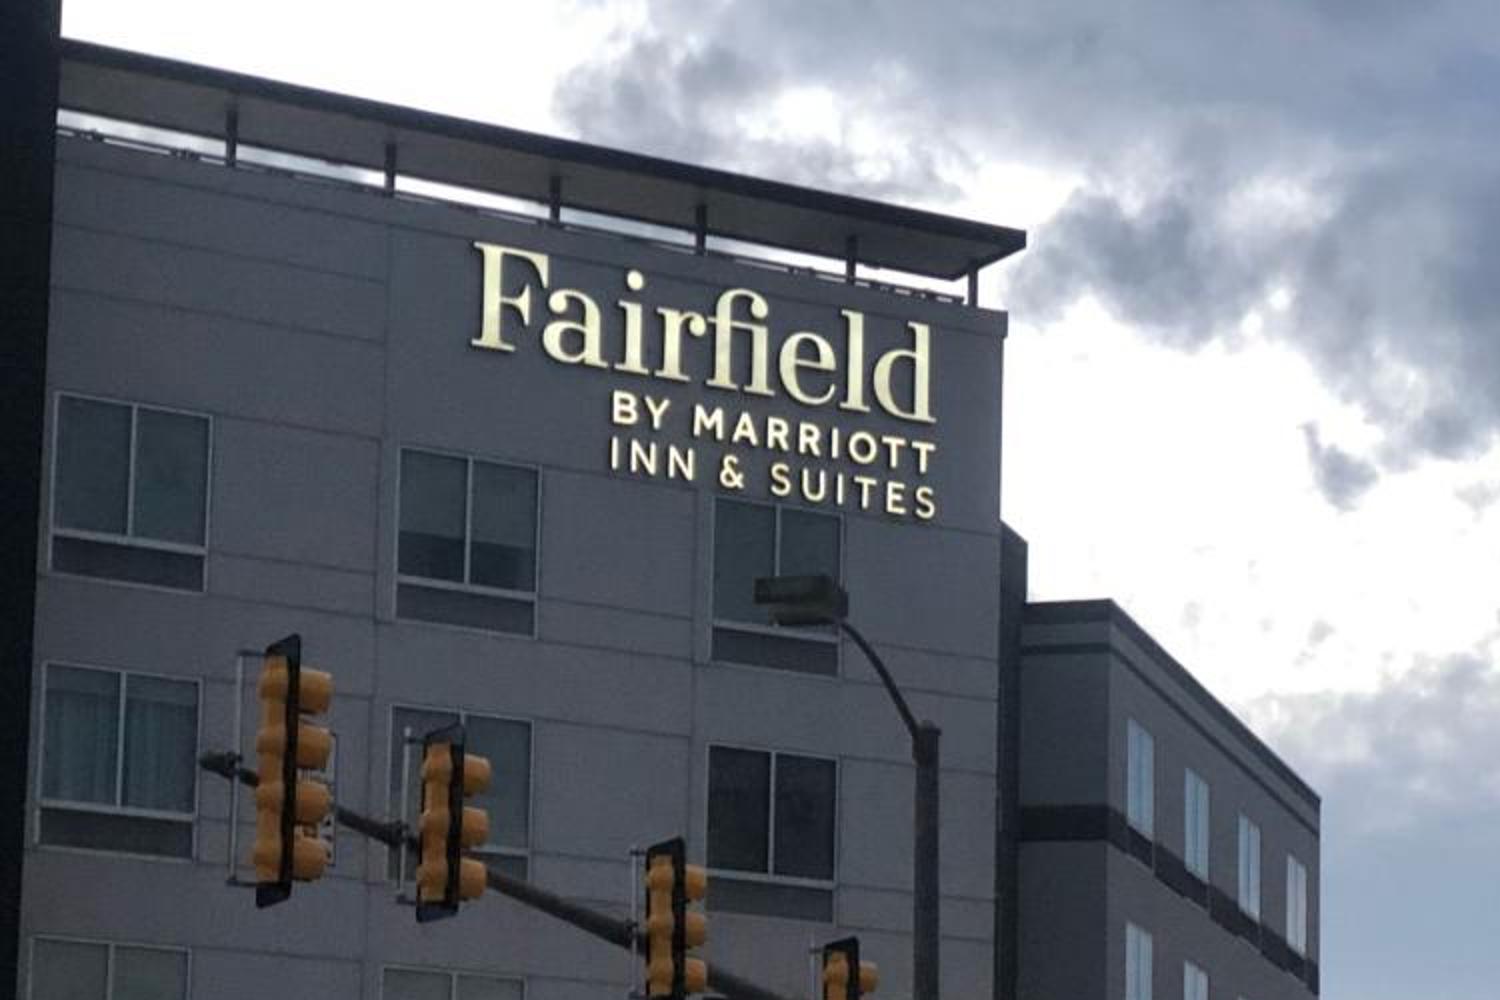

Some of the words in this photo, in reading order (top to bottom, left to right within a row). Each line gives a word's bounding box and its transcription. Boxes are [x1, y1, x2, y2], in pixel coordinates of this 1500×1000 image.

[471, 241, 937, 423] Fairfield
[611, 390, 670, 430] BY
[693, 404, 936, 474] MARRIOTT
[611, 436, 695, 481] INN
[719, 456, 745, 490] &
[770, 463, 936, 520] SUITES
